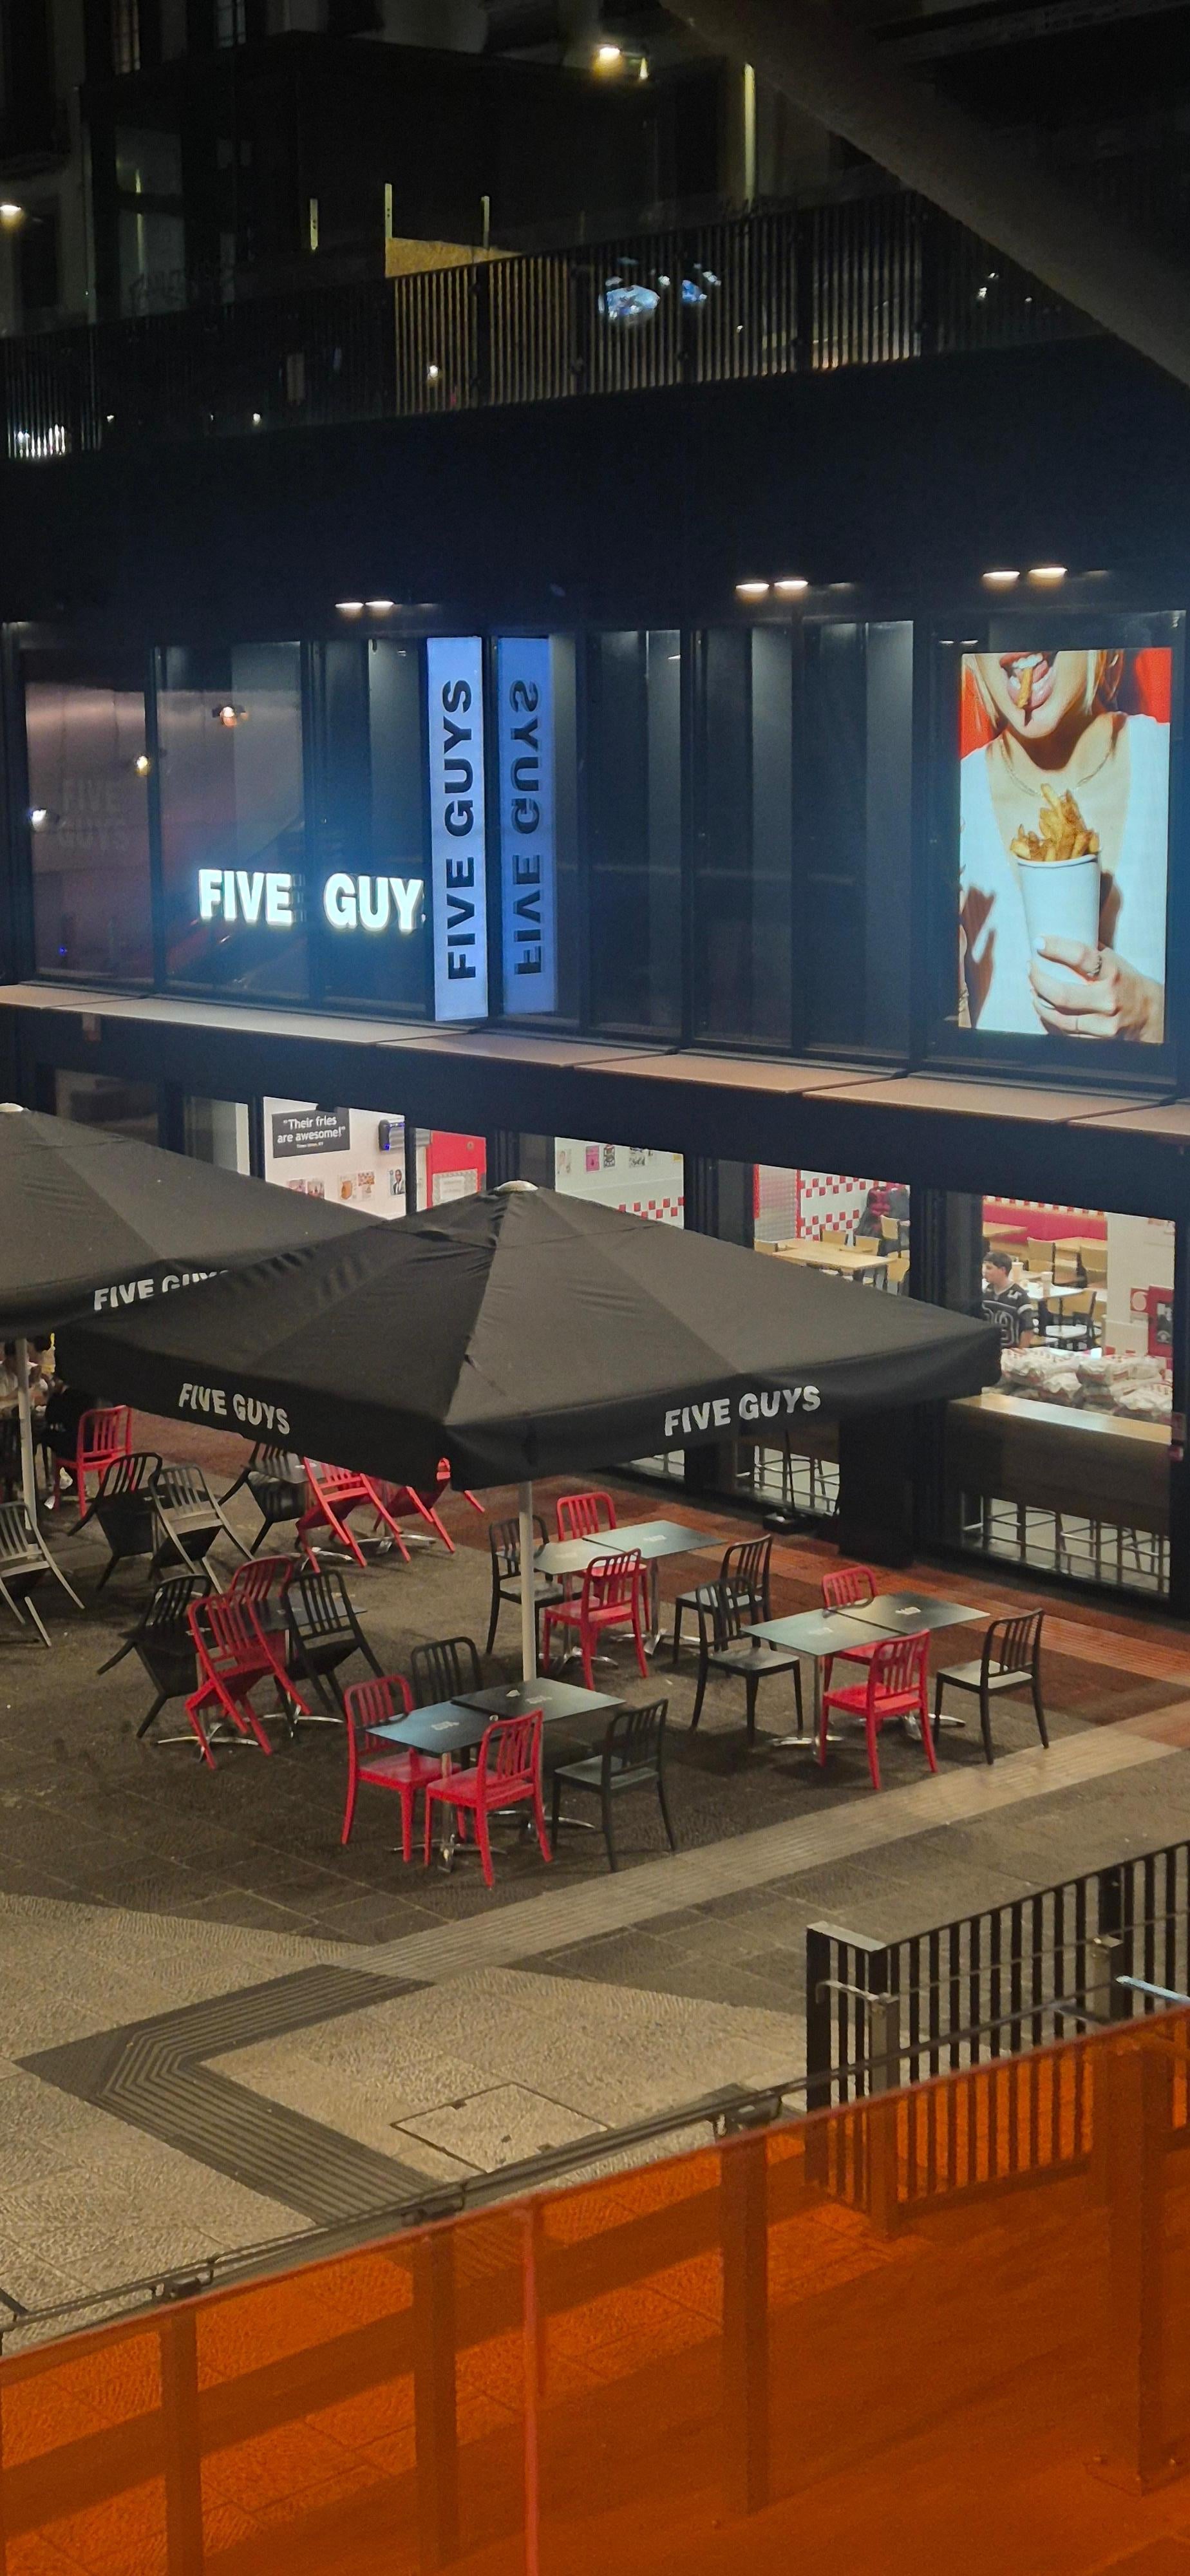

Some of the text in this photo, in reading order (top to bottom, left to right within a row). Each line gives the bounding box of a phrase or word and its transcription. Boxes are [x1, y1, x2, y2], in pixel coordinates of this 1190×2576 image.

[442, 679, 477, 980] FIVE GUYS
[198, 869, 426, 933] FIVE GUY
[277, 1133, 294, 1143] are
[316, 1115, 337, 1126] fries
[93, 1278, 155, 1311] FIVE
[178, 1383, 290, 1435] FIVE GUYS
[664, 1385, 821, 1437] FIVE GUYS
